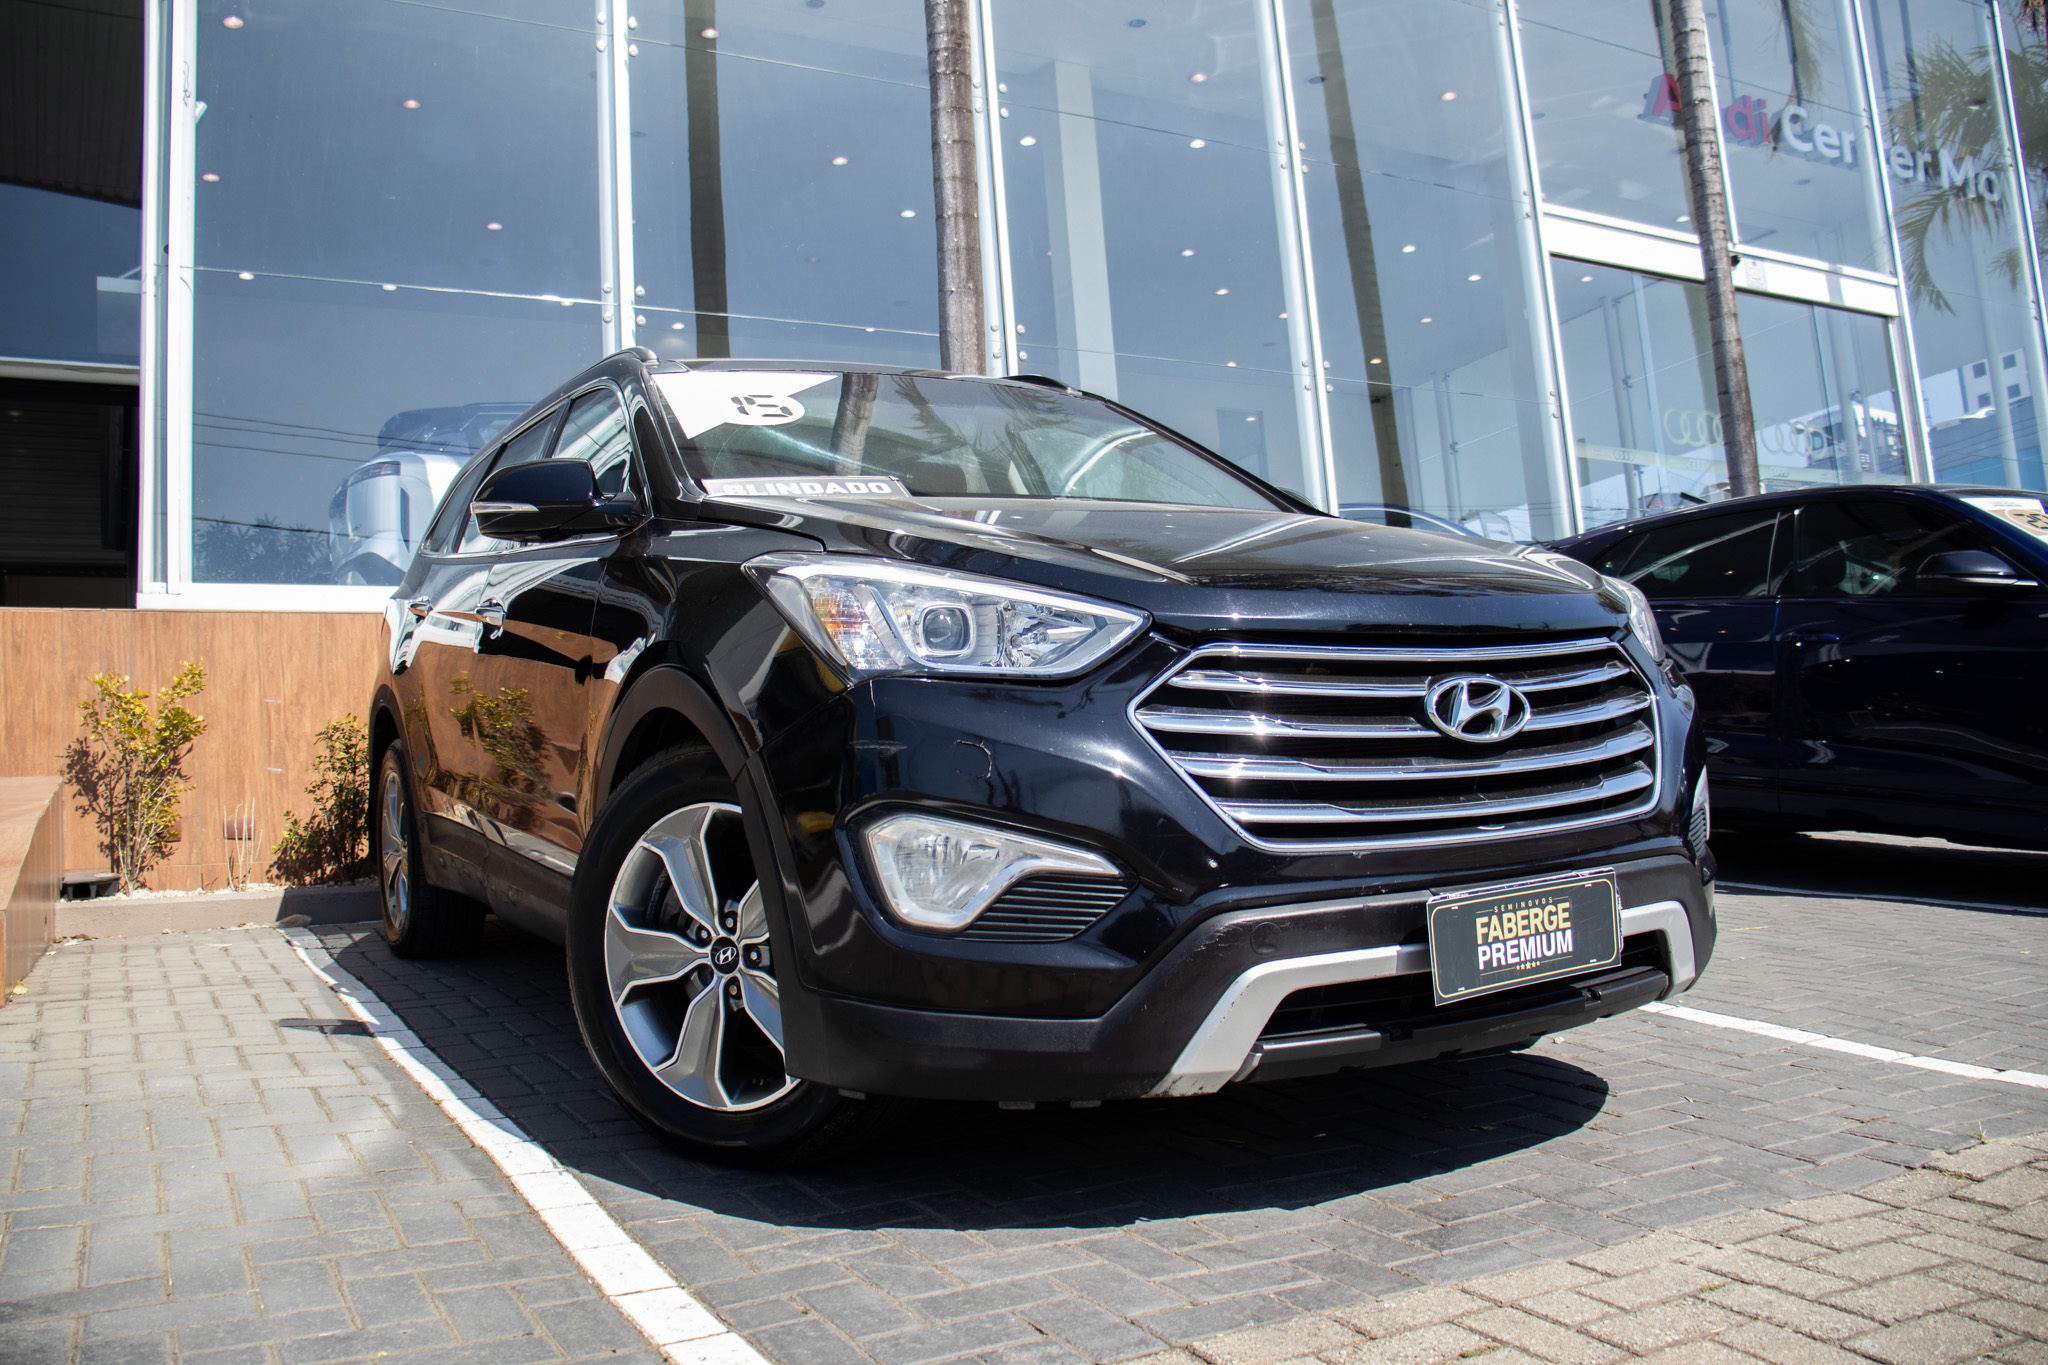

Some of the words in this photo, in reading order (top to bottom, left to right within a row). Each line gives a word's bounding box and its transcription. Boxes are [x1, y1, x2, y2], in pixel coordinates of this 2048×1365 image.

[1654, 72, 1771, 144] Adi
[1780, 105, 1932, 182] Ceer
[730, 394, 794, 418] 15
[722, 481, 893, 496] BLINDADO
[1493, 896, 1554, 913] SEMINOVOS
[1475, 901, 1571, 944] FABERGE
[1477, 928, 1573, 970] PREMIUM
